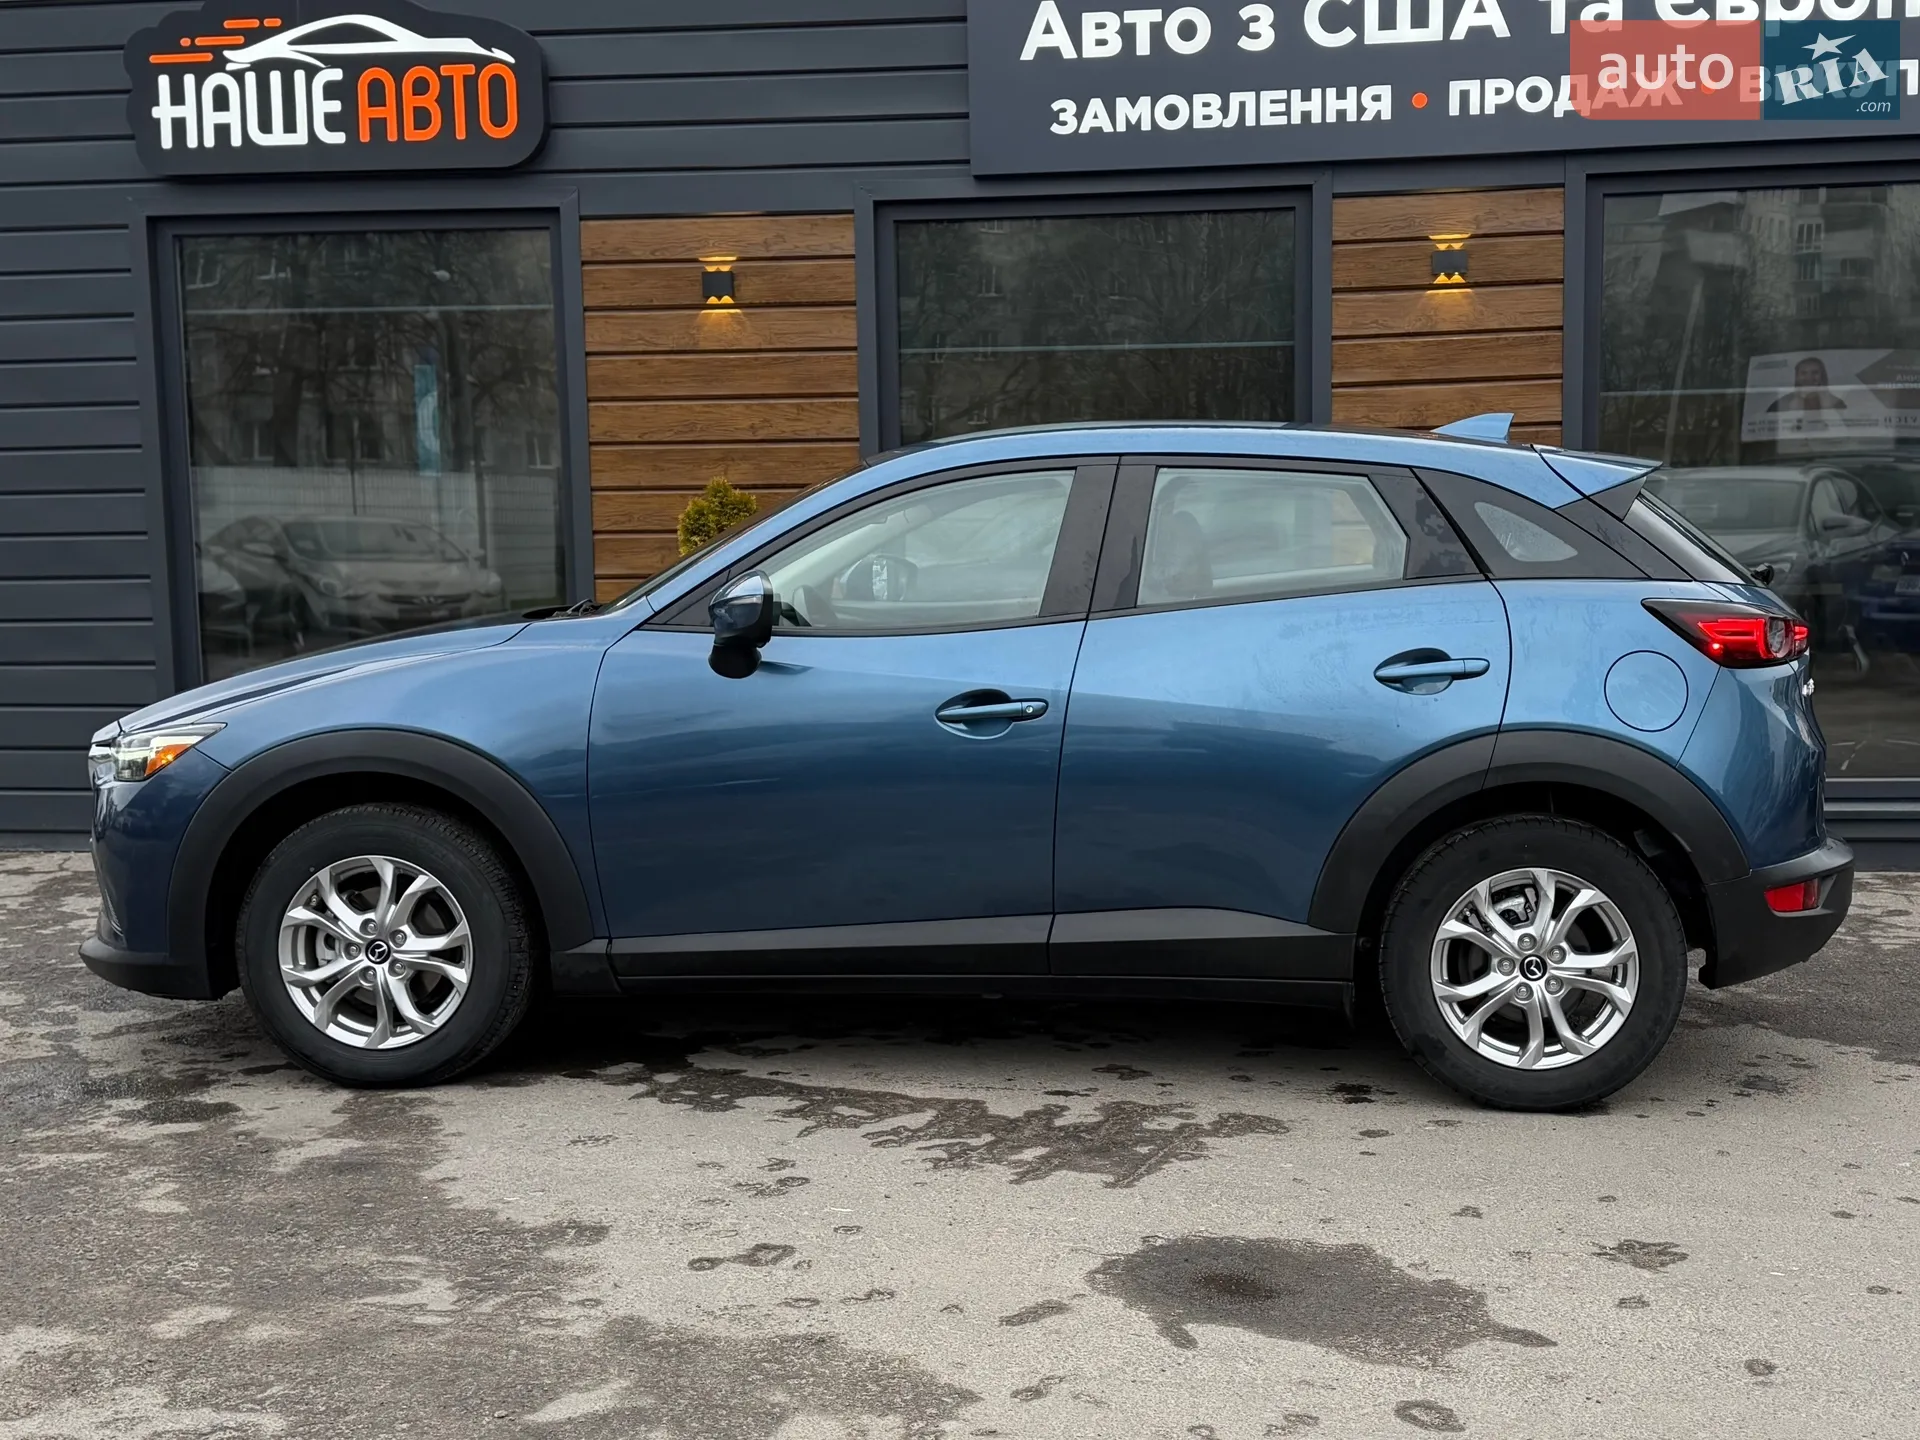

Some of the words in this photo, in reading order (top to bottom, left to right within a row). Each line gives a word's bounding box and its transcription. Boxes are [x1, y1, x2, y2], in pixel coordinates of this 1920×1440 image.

[1019, 0, 1213, 61] Авто
[1303, 0, 1511, 48] США
[152, 68, 347, 150] НАШЕ
[357, 62, 518, 142] АВТО
[1049, 84, 1393, 136] ЗАМОВЛЕННЯ
[1448, 68, 1684, 118] ПРОДАЖ
